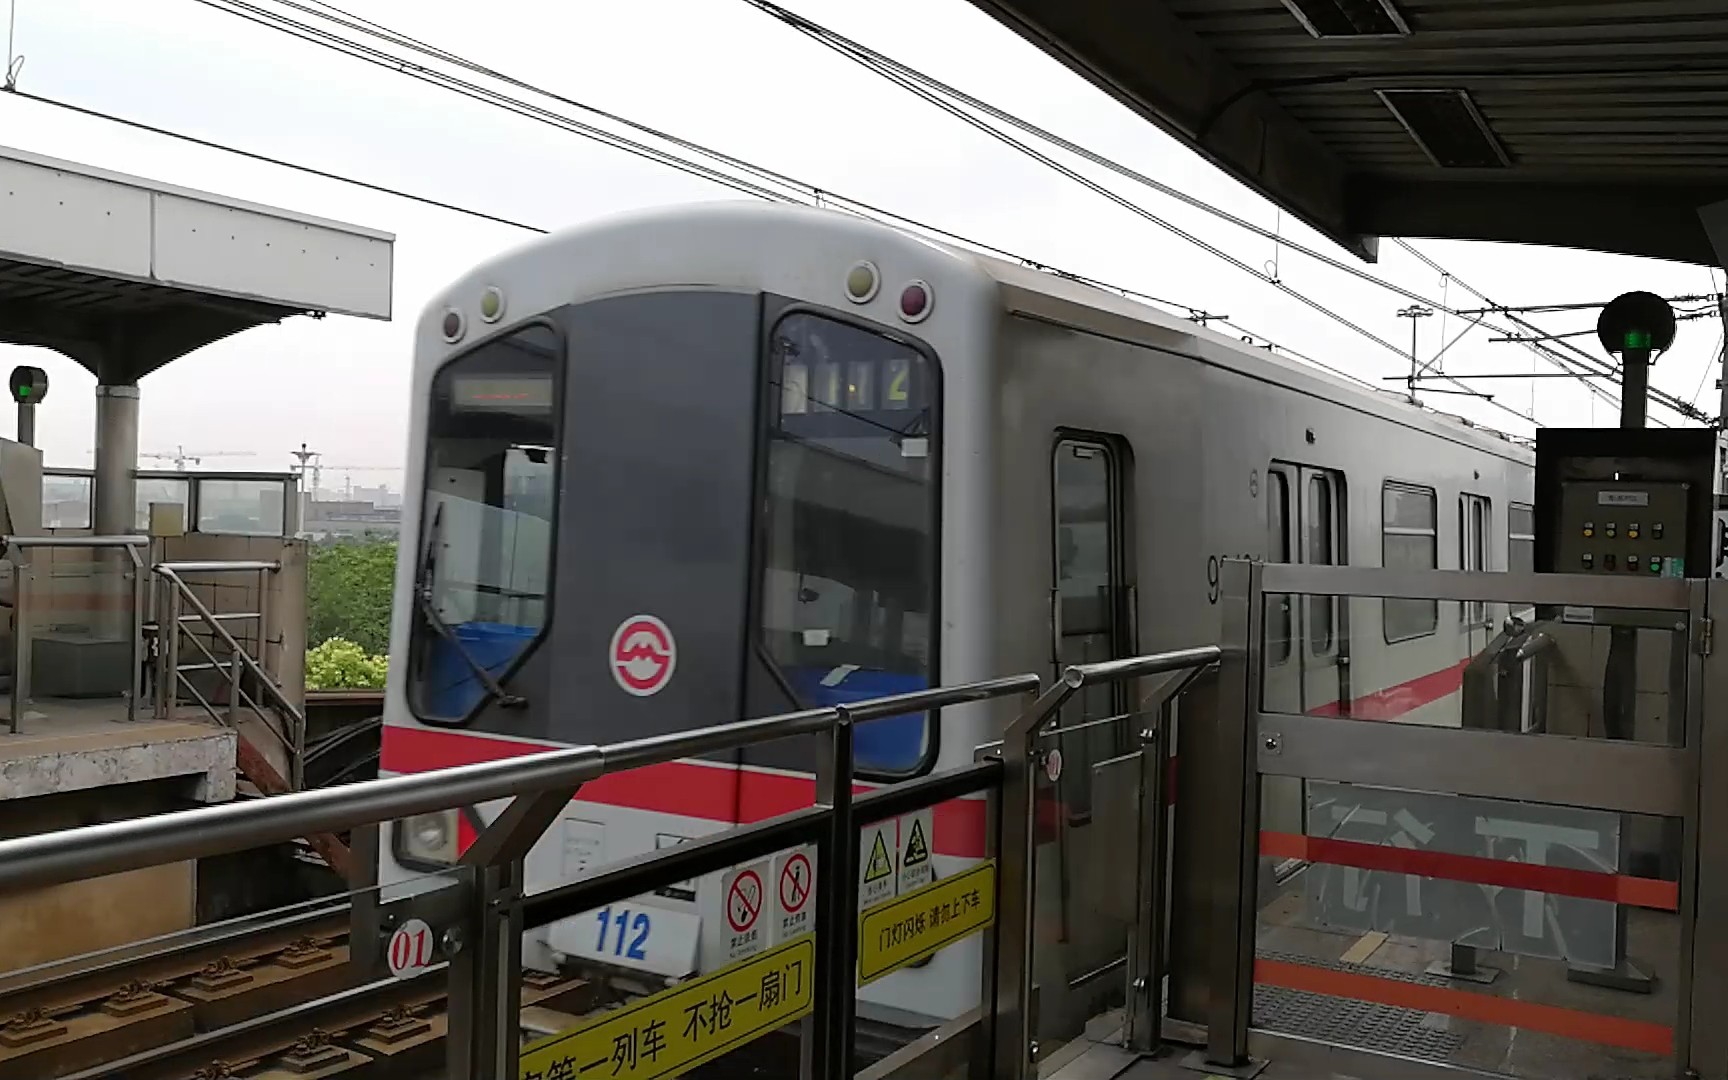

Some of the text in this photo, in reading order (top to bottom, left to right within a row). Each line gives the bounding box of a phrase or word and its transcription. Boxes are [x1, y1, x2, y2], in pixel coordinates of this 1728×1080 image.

[928, 888, 981, 928] 请勿上下车
[392, 929, 433, 971] 01
[596, 905, 651, 961] 112
[523, 959, 803, 1080] 等一列车 不抢一扇门
